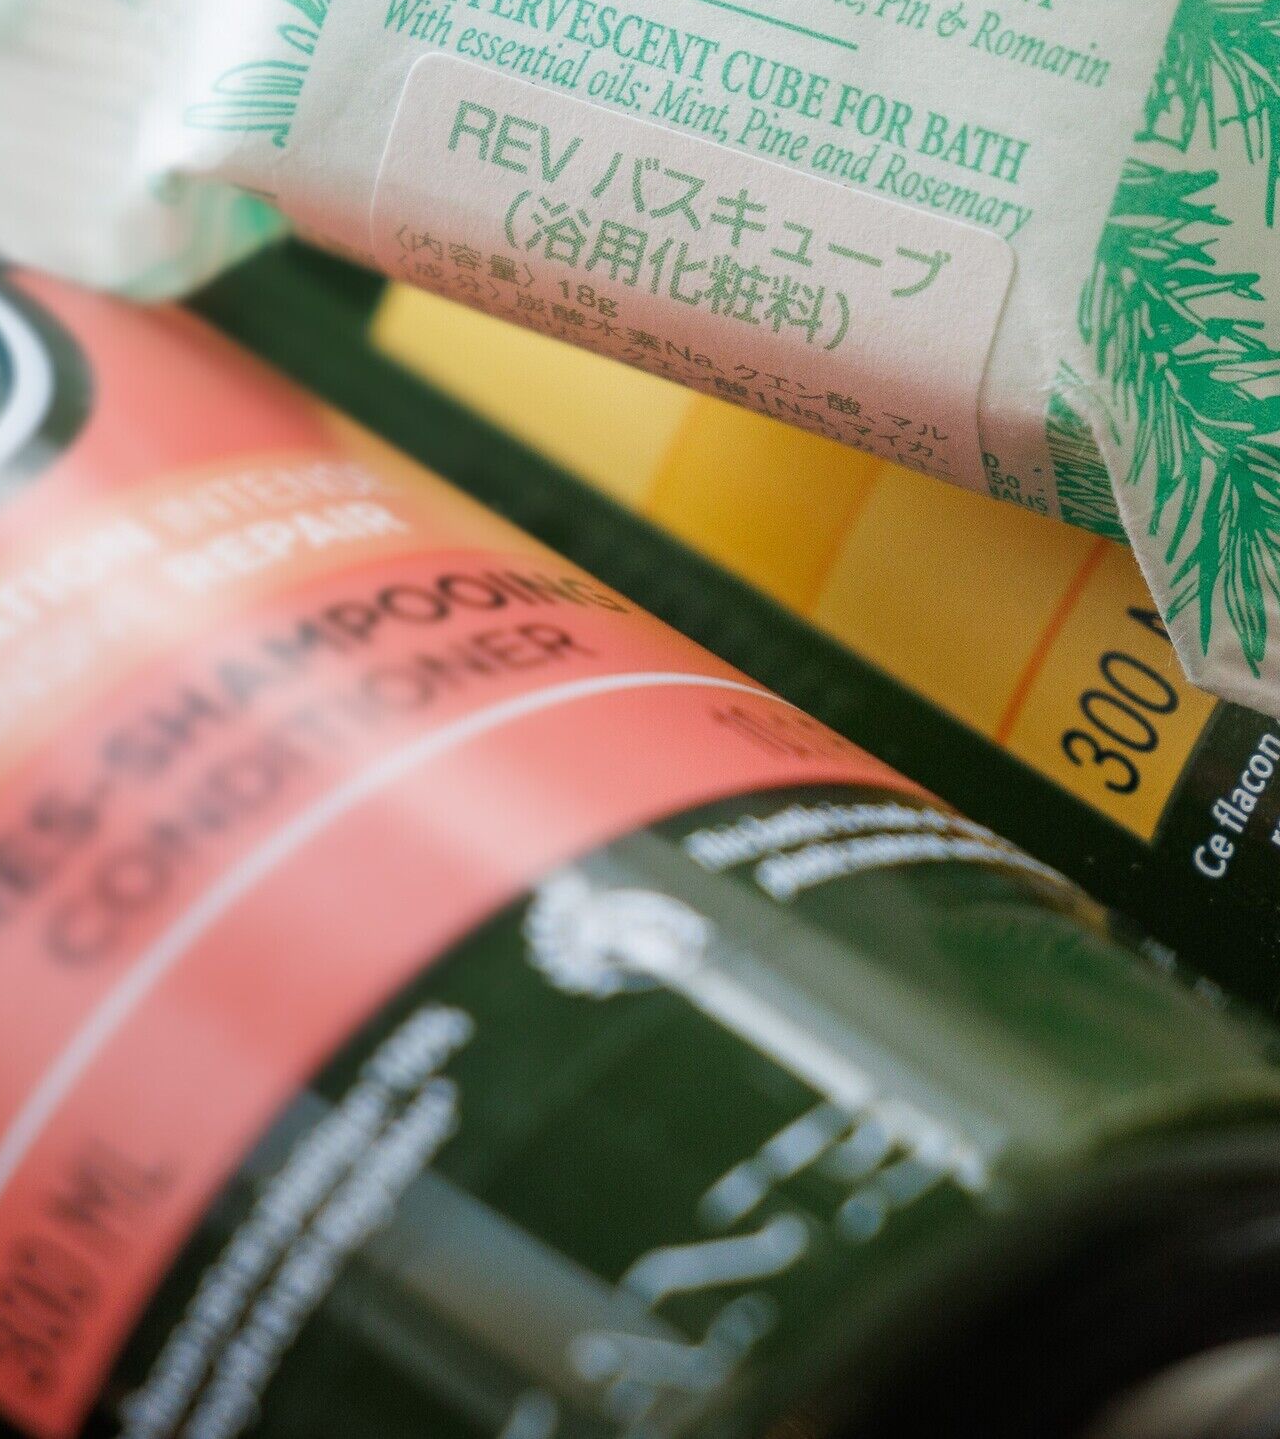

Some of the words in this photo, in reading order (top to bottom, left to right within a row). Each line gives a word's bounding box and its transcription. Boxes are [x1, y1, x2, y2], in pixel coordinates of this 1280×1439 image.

[936, 1, 968, 38] &
[969, 9, 1112, 88] Romarin
[455, 26, 592, 90] essential
[587, 63, 650, 111] oils:
[648, 80, 730, 144] Mint,
[735, 106, 812, 163] Pine
[811, 140, 882, 184] and
[874, 152, 1033, 242] Rosemary
[720, 49, 831, 119] CUBE
[829, 83, 914, 148] FOR
[917, 111, 1030, 184] BATH
[447, 100, 584, 184] REV
[590, 151, 953, 298] バスキューブ
[1060, 649, 1180, 796] 300
[1192, 835, 1237, 880] Ce
